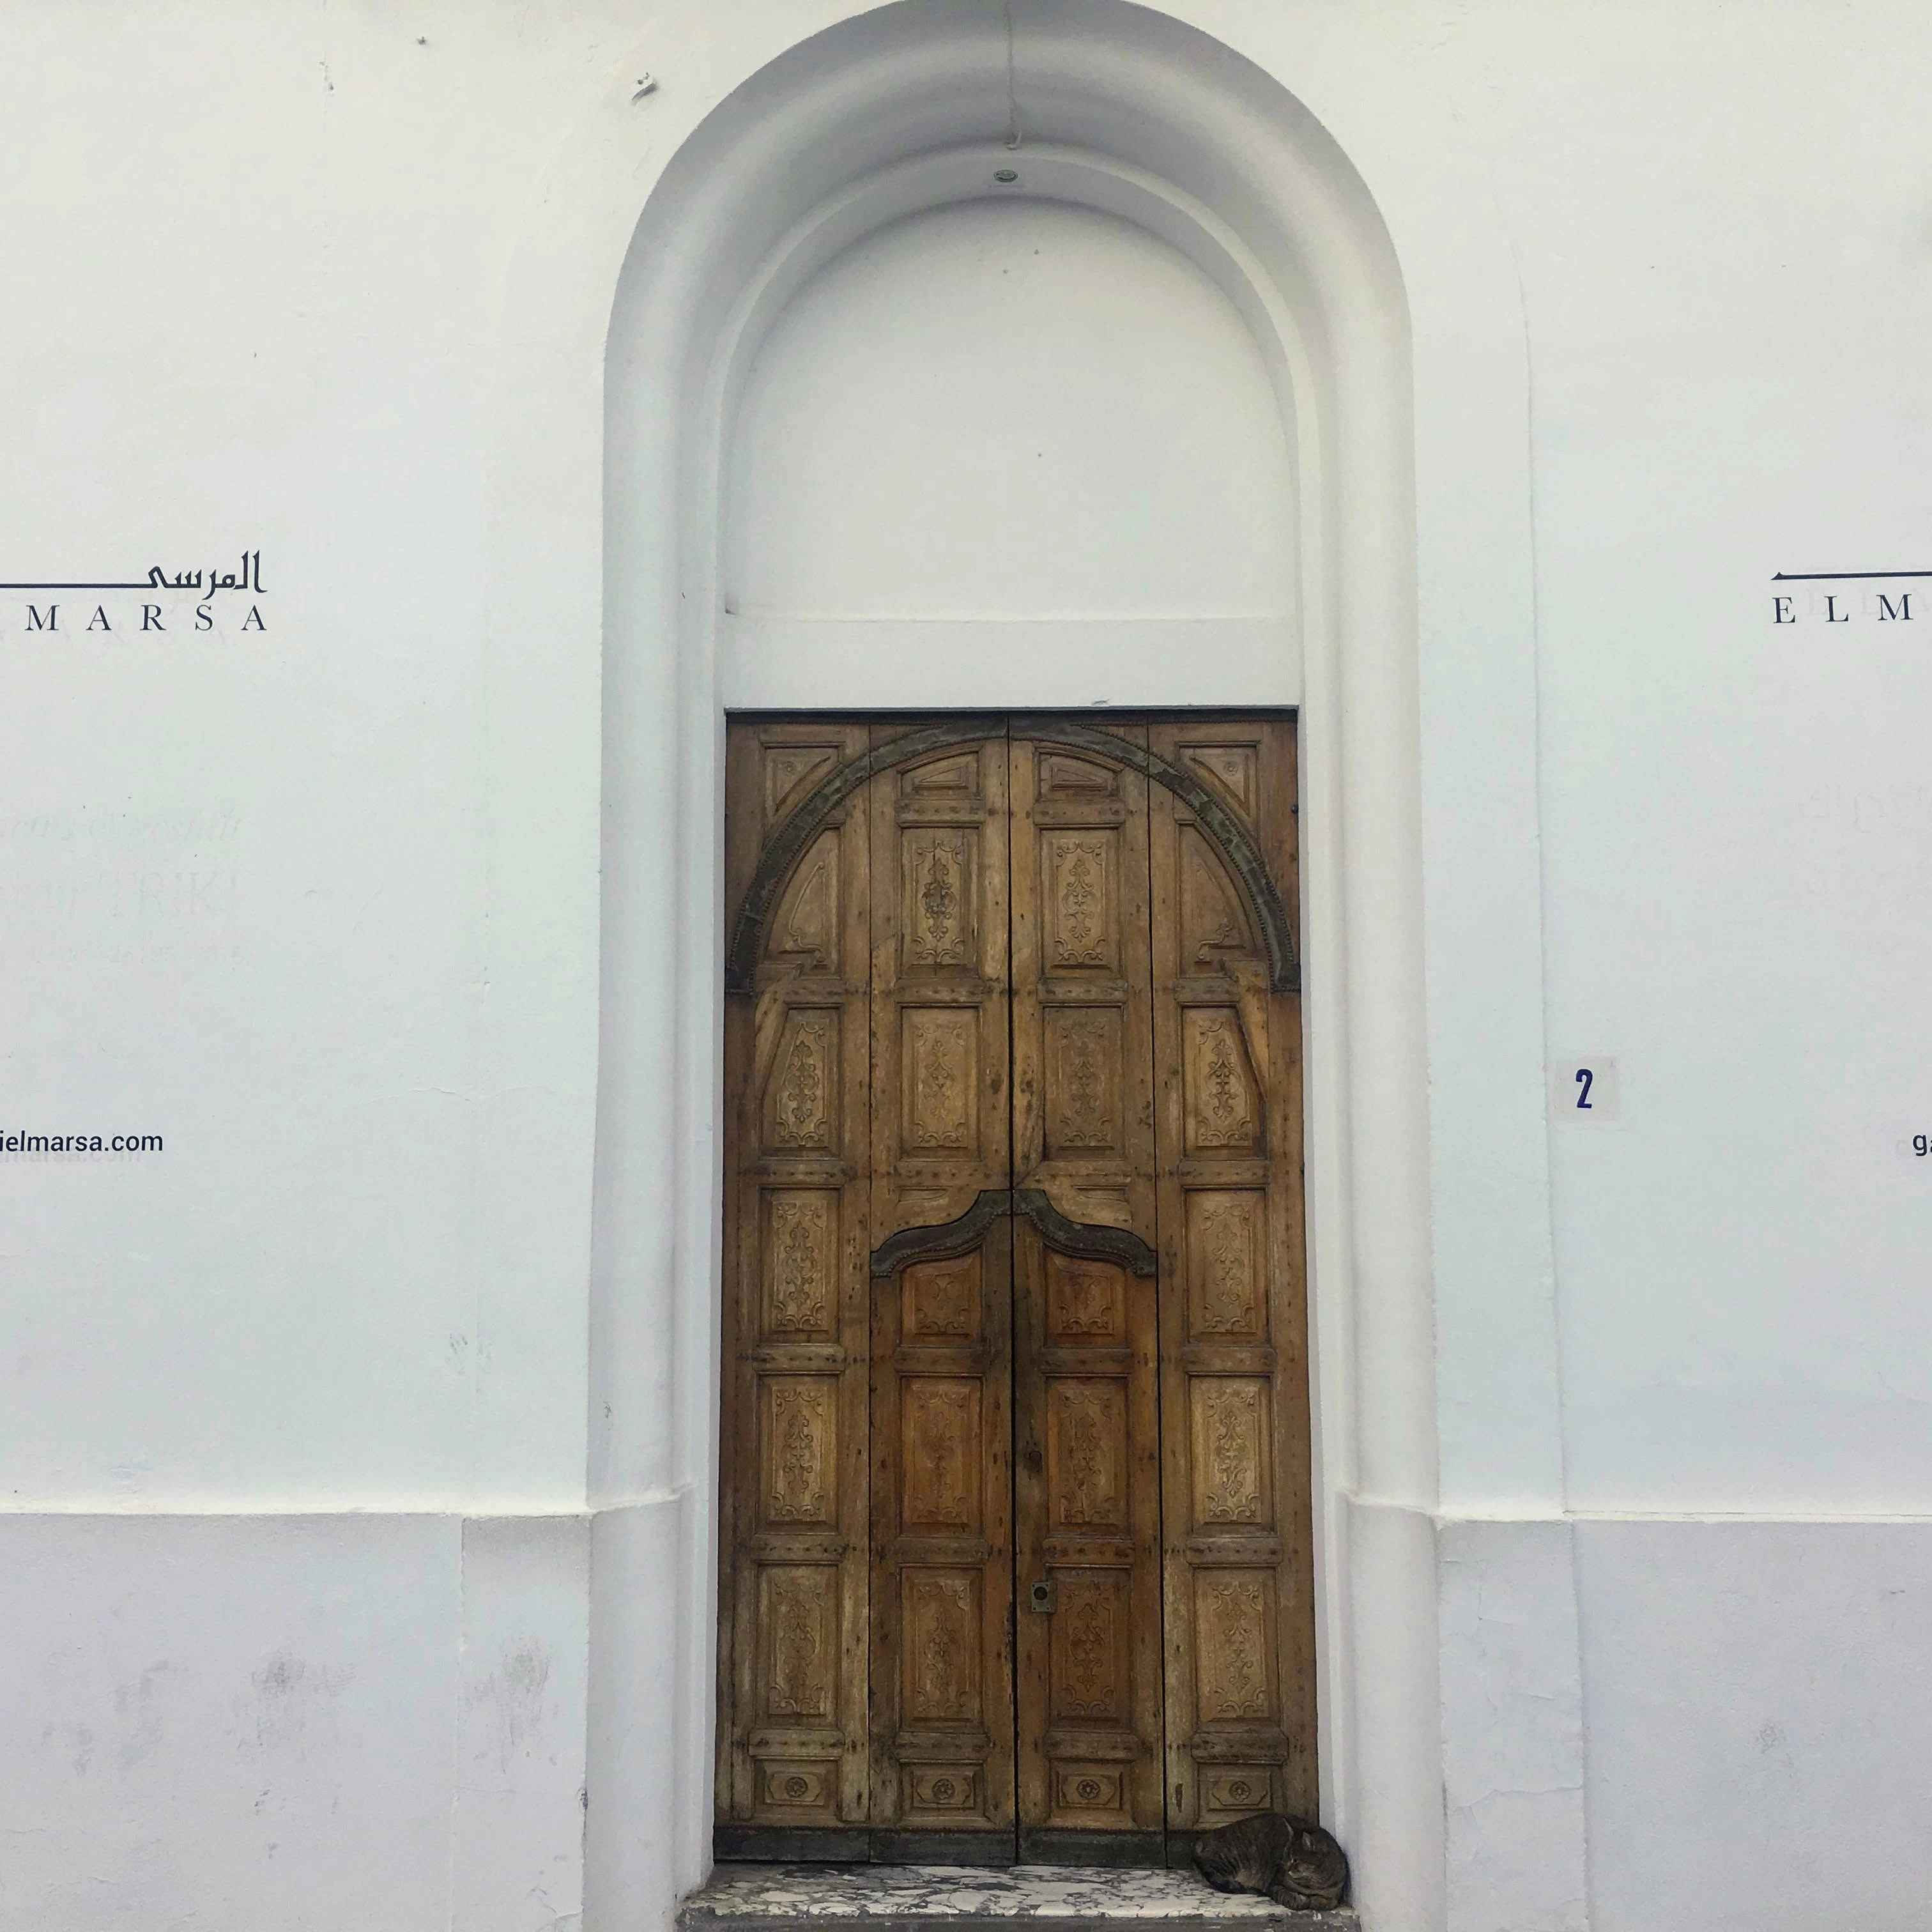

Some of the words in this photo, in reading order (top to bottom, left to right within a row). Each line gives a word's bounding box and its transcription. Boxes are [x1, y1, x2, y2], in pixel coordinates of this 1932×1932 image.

[148, 550, 268, 601] المرسى
[24, 604, 267, 631] MARSA
[1575, 1068, 1593, 1109] 2
[1913, 1135, 1932, 1157] g
